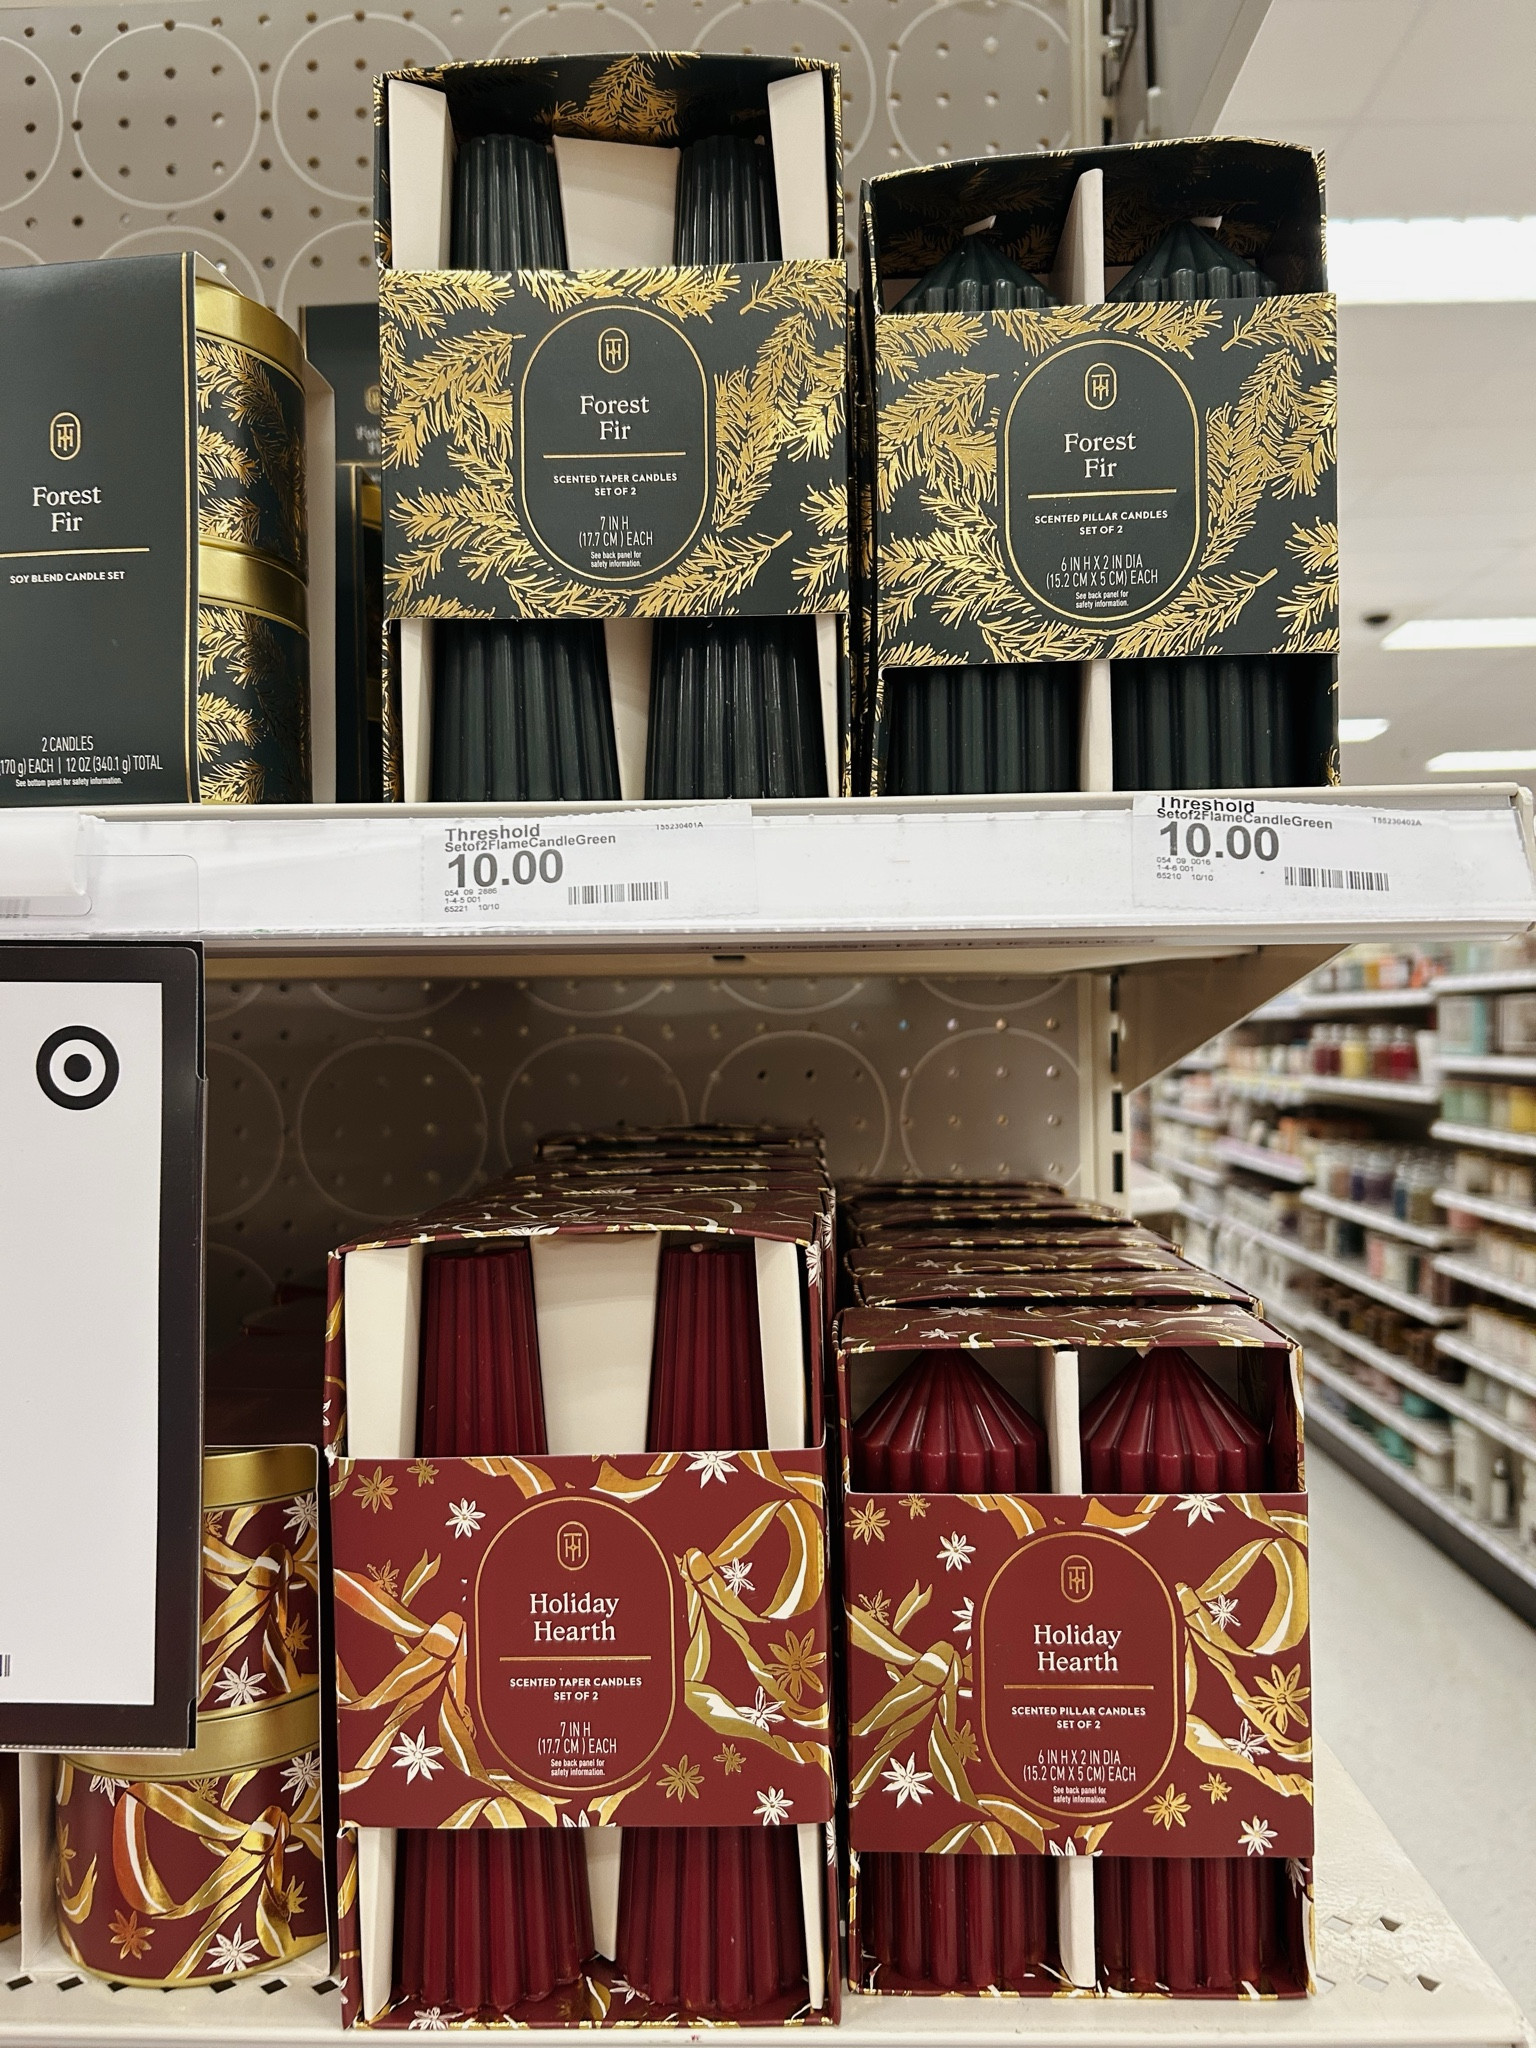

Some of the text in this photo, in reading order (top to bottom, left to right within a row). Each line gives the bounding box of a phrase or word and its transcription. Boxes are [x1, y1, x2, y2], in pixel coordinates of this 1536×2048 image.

[580, 395, 649, 414] Forest
[600, 421, 631, 440] Fir
[1064, 432, 1137, 453] Forest
[1084, 458, 1117, 478] Fir
[553, 473, 677, 484] SCENTED TAPER CANDLES
[32, 486, 102, 507] Forest
[594, 487, 637, 496] SET OF 2
[51, 511, 83, 532] Fir
[600, 516, 629, 530] 7 IN H
[1034, 510, 1168, 524] SCENTED PILLAR CANDLES
[1079, 525, 1123, 535] SET OF 2
[578, 531, 600, 548] (17.7
[626, 531, 653, 546] EACH
[617, 551, 632, 560] panel
[1061, 554, 1143, 571] 6 IN H X 2 IN DIA
[590, 560, 608, 569] safety
[10, 571, 125, 584] SOY BLEND CANDLE SET
[1046, 569, 1158, 589] (15.2 CM X 5 CM) EACH
[1075, 590, 1128, 600] See back panel for
[1075, 600, 1128, 609] safety information.
[42, 736, 94, 752] 2 CANDLES
[0, 759, 16, 776] 170
[28, 758, 54, 773] EACH
[66, 757, 77, 772] 12
[78, 757, 91, 772] OZ
[92, 756, 119, 773] (340.1
[133, 755, 163, 770] TOTAL
[16, 779, 26, 787] See
[47, 778, 62, 787] panel
[72, 777, 89, 786] safety
[1157, 808, 1332, 829] Setof2FlameCandleGreen
[445, 823, 540, 841] Threshold
[445, 834, 616, 852] Setof2FlameCandleGreen
[1160, 821, 1279, 861] 10.00
[448, 849, 563, 888] 10.00
[530, 1592, 619, 1618] Holiday
[534, 1620, 616, 1641] Hearth
[1034, 1624, 1122, 1649] Holiday
[1038, 1651, 1118, 1672] Hearth
[510, 1677, 642, 1687] SCENTED TAPER CANDLES
[554, 1692, 598, 1701] SET OF 2
[1011, 1706, 1146, 1716] SCENTED PILLAR CANDLES
[560, 1721, 591, 1737] 7 IN H
[1057, 1720, 1101, 1729] SET OF 2
[538, 1738, 560, 1755] (17.7
[589, 1738, 617, 1753] EACH
[550, 1759, 562, 1767] See
[563, 1759, 577, 1767] back
[579, 1759, 595, 1768] panel
[1038, 1749, 1121, 1764] 6 IN H X 2 IN DIA
[551, 1768, 605, 1777] safety information.
[1023, 1765, 1136, 1782] (15.2 CM X 5 CM) EACH
[1053, 1786, 1106, 1795] See back panel for
[1053, 1796, 1071, 1804] safety
